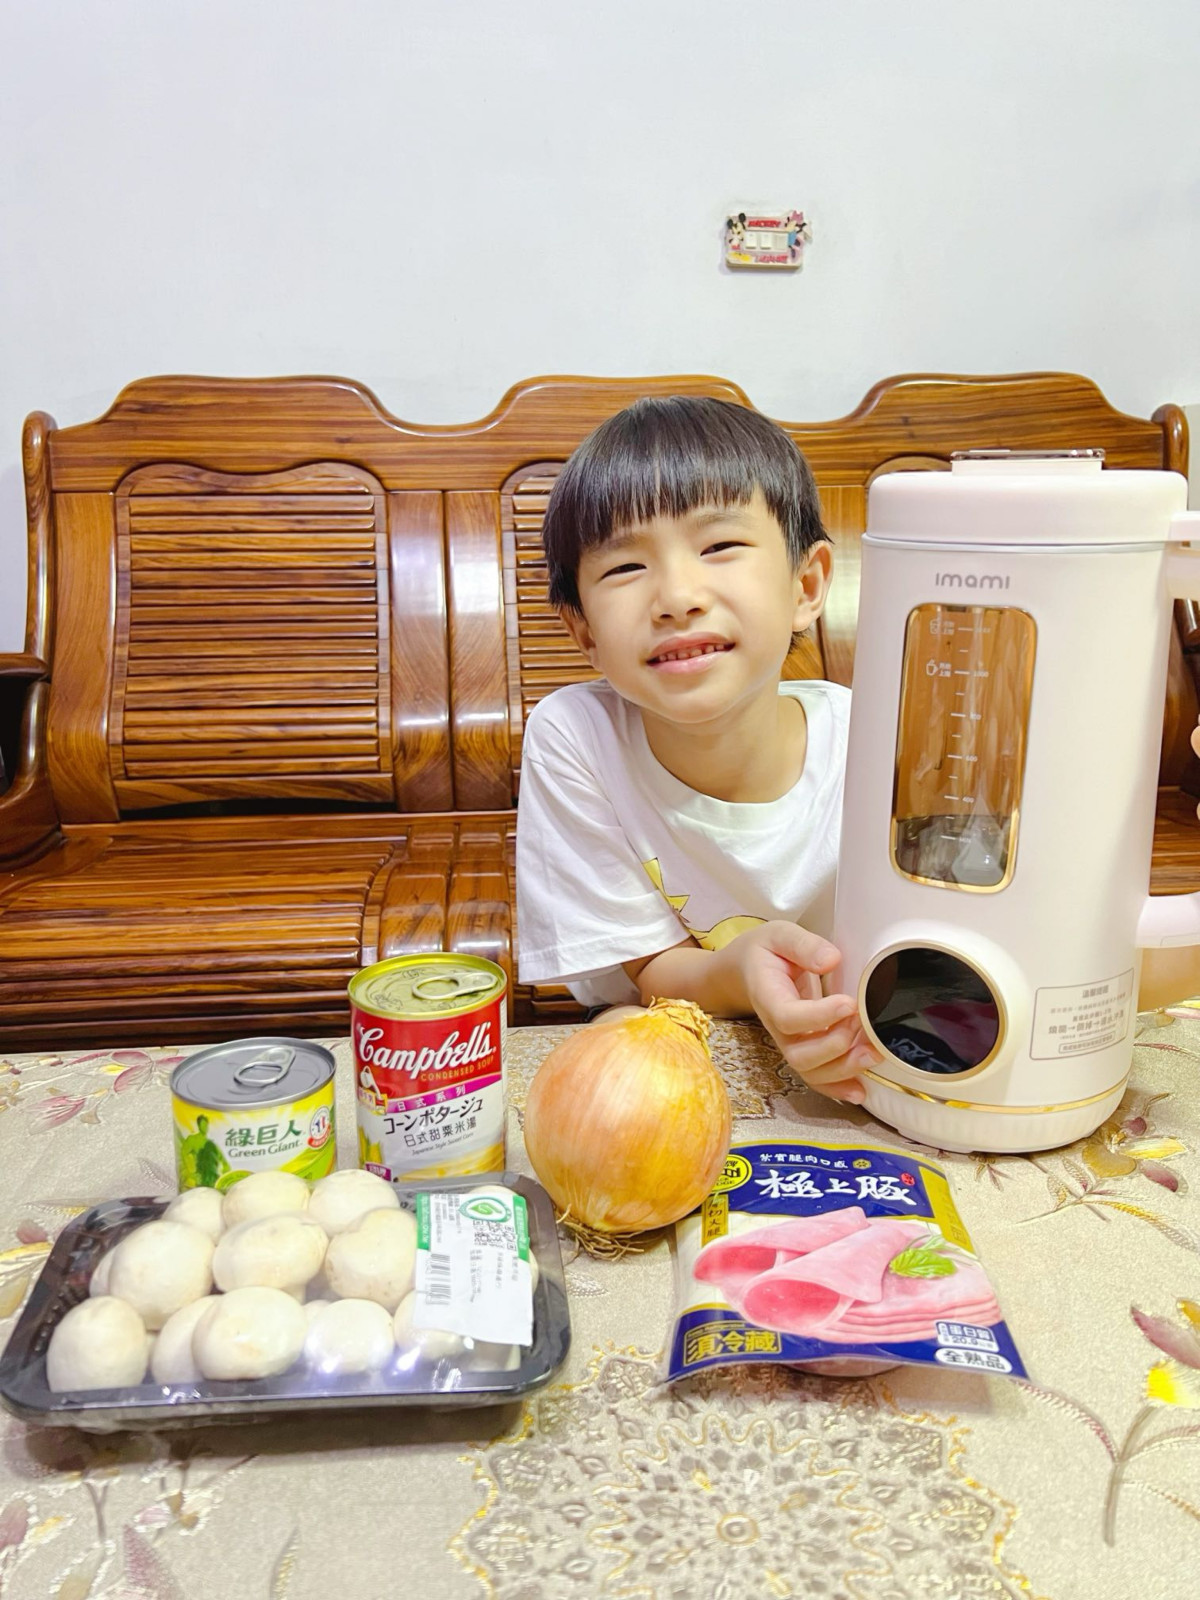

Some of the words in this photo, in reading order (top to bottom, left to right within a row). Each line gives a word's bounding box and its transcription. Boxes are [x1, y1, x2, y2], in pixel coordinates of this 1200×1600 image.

[358, 1022, 495, 1079] Campbell's
[421, 1066, 475, 1082] CONDENSED
[477, 1056, 495, 1071] SOUP
[397, 1084, 466, 1111] 日式系列
[384, 1097, 484, 1135] コーンポタージュ
[225, 1119, 302, 1147] 綠巨人
[228, 1147, 266, 1158] Green
[268, 1139, 300, 1154] Giant
[754, 1169, 917, 1206] 極上豚
[687, 1329, 777, 1362] 須冷藏
[943, 1350, 1006, 1370] 全熟品
